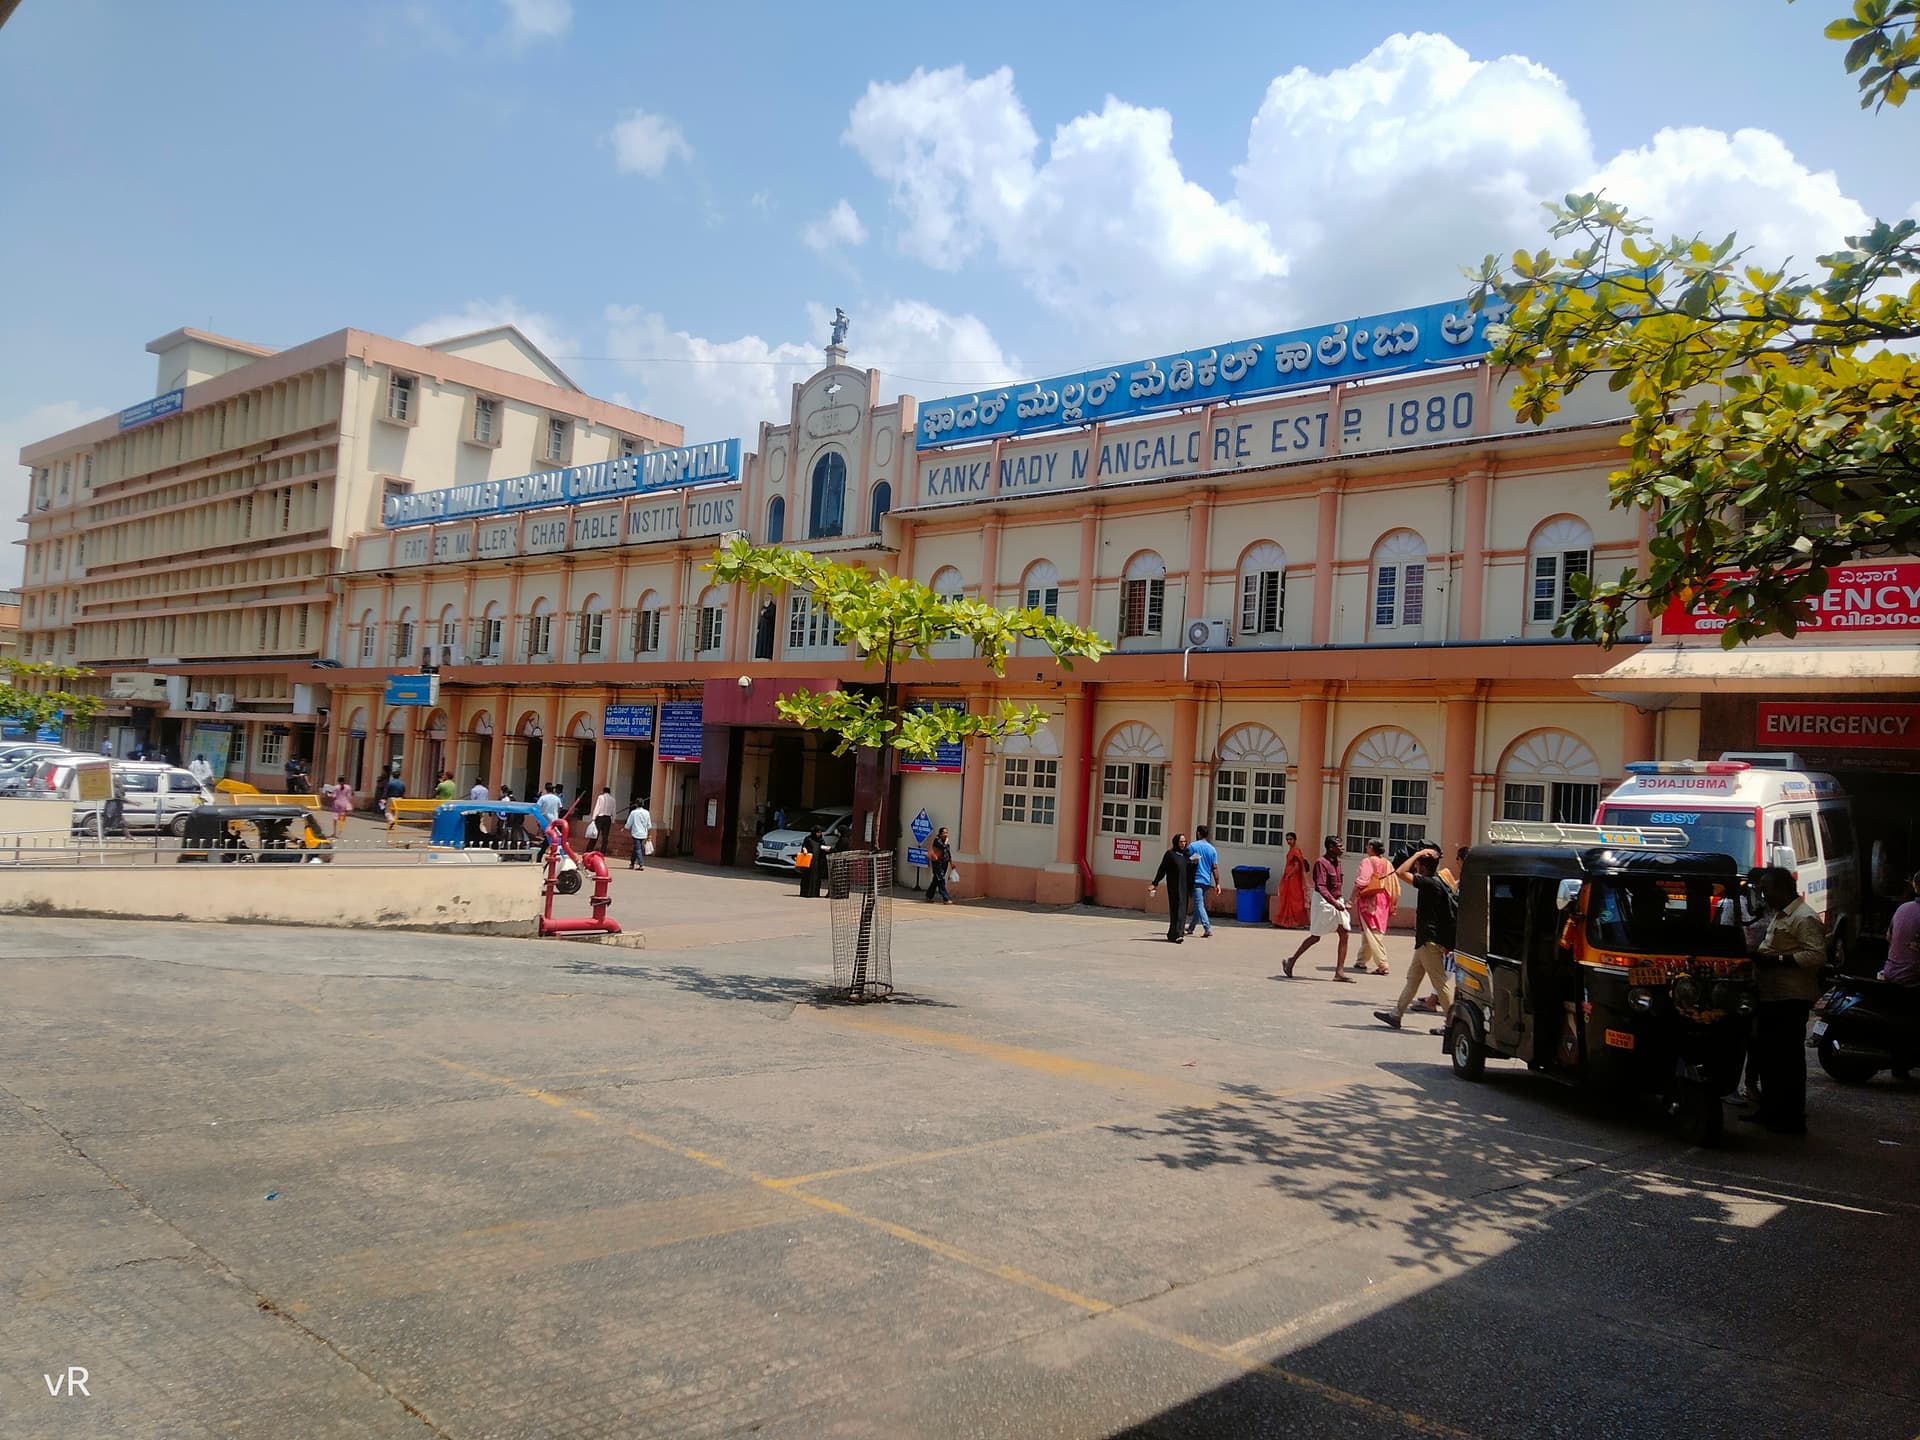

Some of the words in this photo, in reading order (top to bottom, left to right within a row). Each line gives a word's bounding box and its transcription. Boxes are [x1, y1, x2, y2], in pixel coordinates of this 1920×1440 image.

[1129, 343, 1263, 399] ಮೆಡಿಕಲ್
[1275, 322, 1419, 373] ಕಾಲೇಜು
[1388, 392, 1473, 438] 1880
[503, 471, 564, 507] MEDICAL
[569, 458, 637, 497] COLLEGE
[642, 444, 729, 486] HOSPITAL
[606, 716, 631, 726] MEDICAL
[632, 717, 650, 726] STORE
[1766, 714, 1910, 736] EMERGENCY
